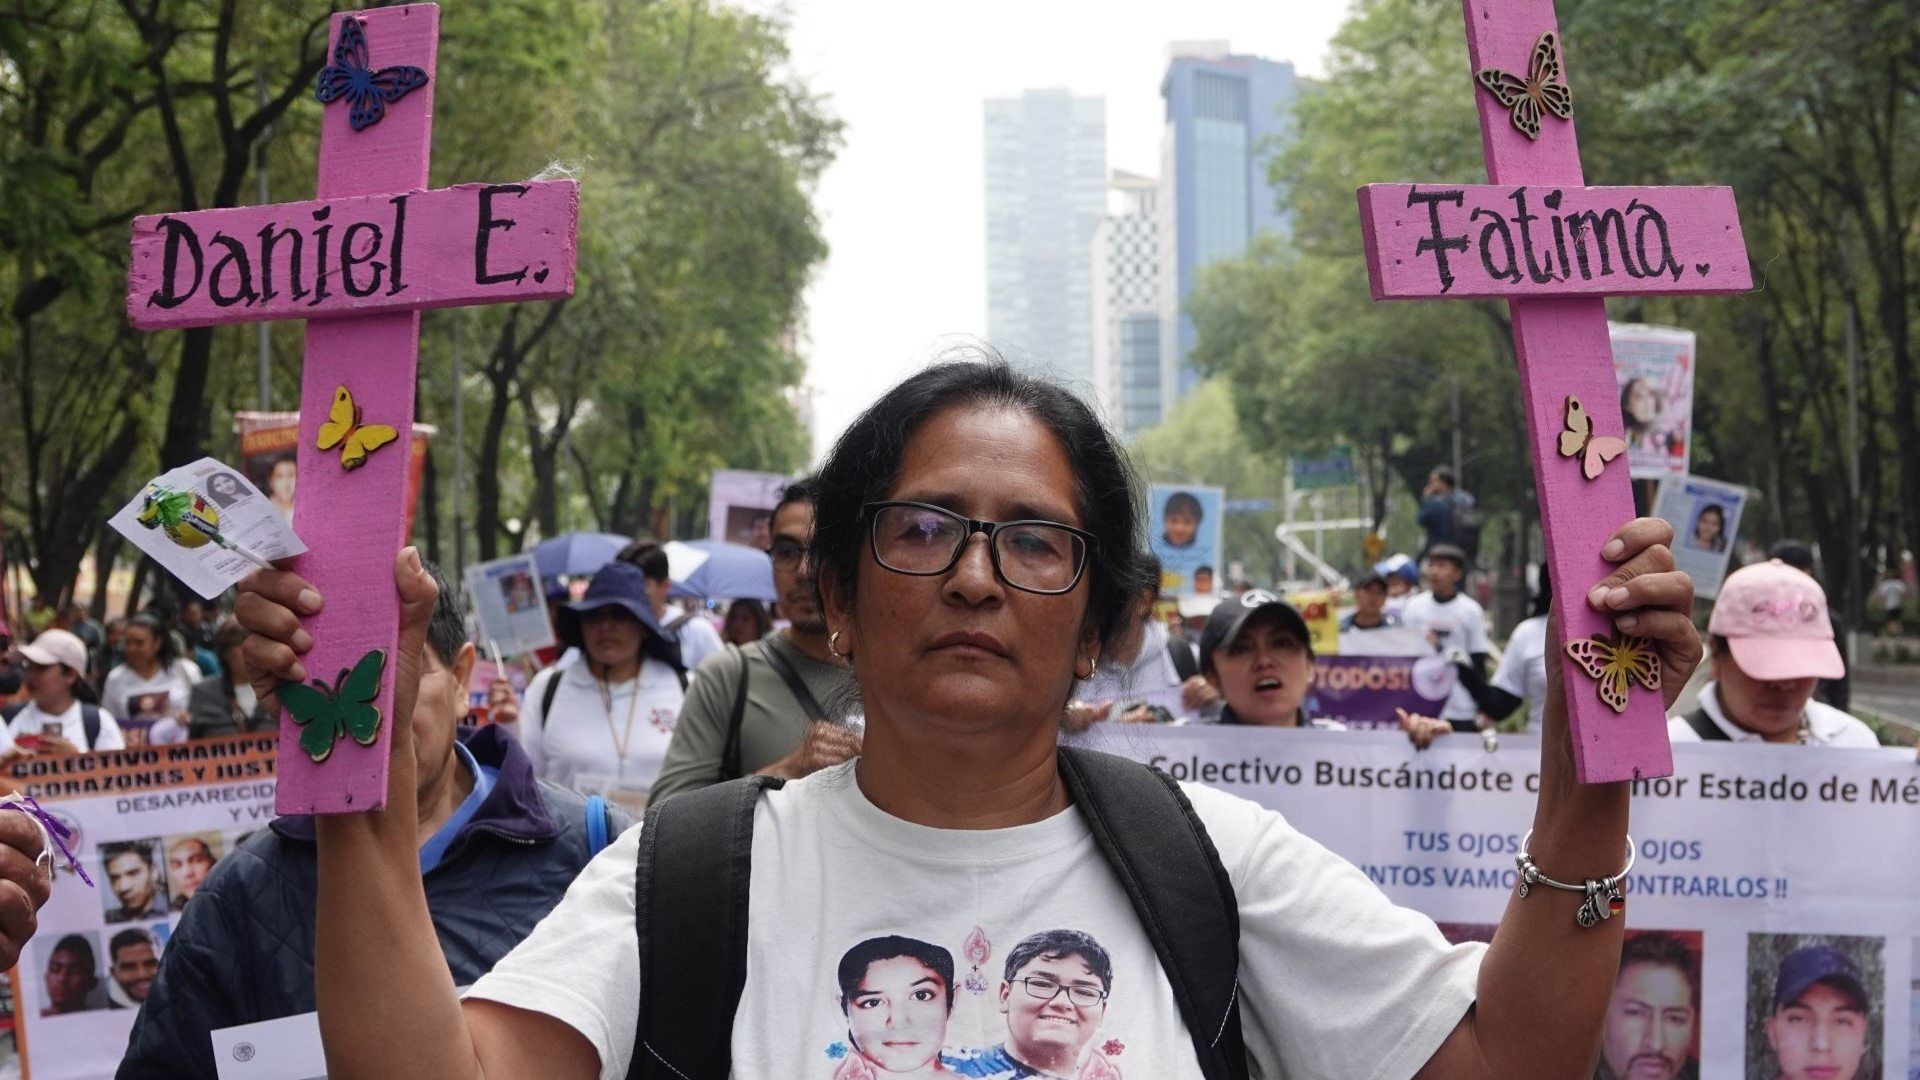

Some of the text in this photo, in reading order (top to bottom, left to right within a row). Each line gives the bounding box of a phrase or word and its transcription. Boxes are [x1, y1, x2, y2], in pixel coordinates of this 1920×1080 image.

[148, 185, 549, 309] Daniel E.
[11, 750, 160, 779] COLECTIVO
[26, 767, 184, 799] CORAZONES
[191, 766, 207, 781] Y
[1315, 760, 1514, 792] Buscándote
[1699, 773, 1808, 801] Estado
[1819, 774, 1858, 803] de
[229, 808, 241, 823] Y
[1404, 831, 1450, 852] TUS
[1458, 832, 1519, 858] OJOS
[1641, 839, 1701, 864] OJOS
[1361, 865, 1436, 887] NTOS
